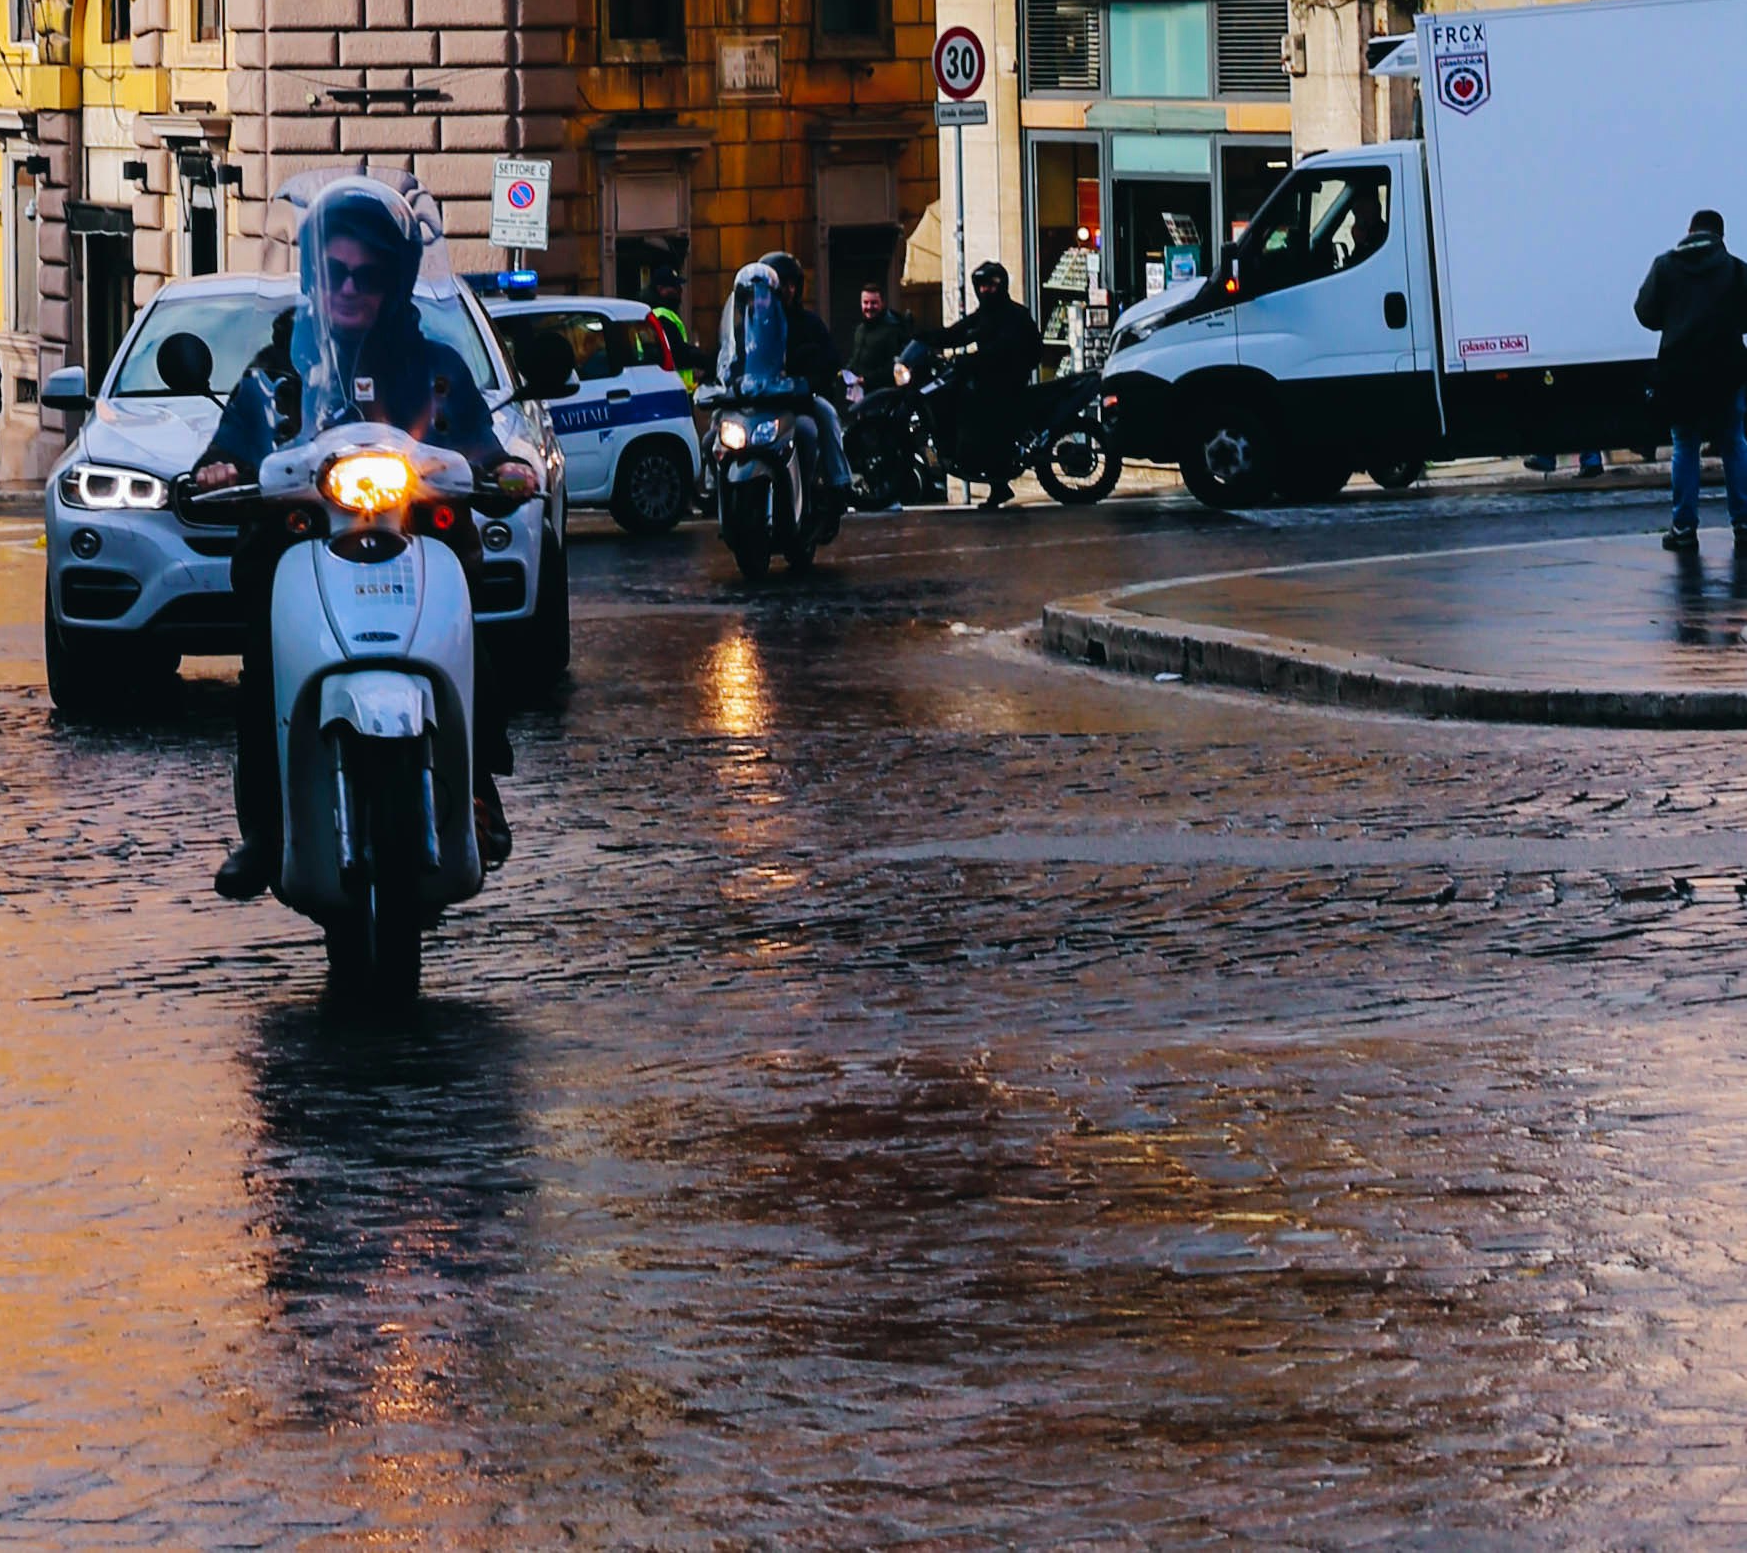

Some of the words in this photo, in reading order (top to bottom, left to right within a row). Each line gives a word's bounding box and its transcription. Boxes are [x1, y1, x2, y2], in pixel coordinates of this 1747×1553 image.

[1434, 24, 1485, 45] FRCX
[946, 45, 975, 81] 30
[498, 162, 537, 176] SETTORE
[539, 165, 547, 177] C
[1461, 338, 1497, 353] plasto
[1499, 336, 1525, 350] blok
